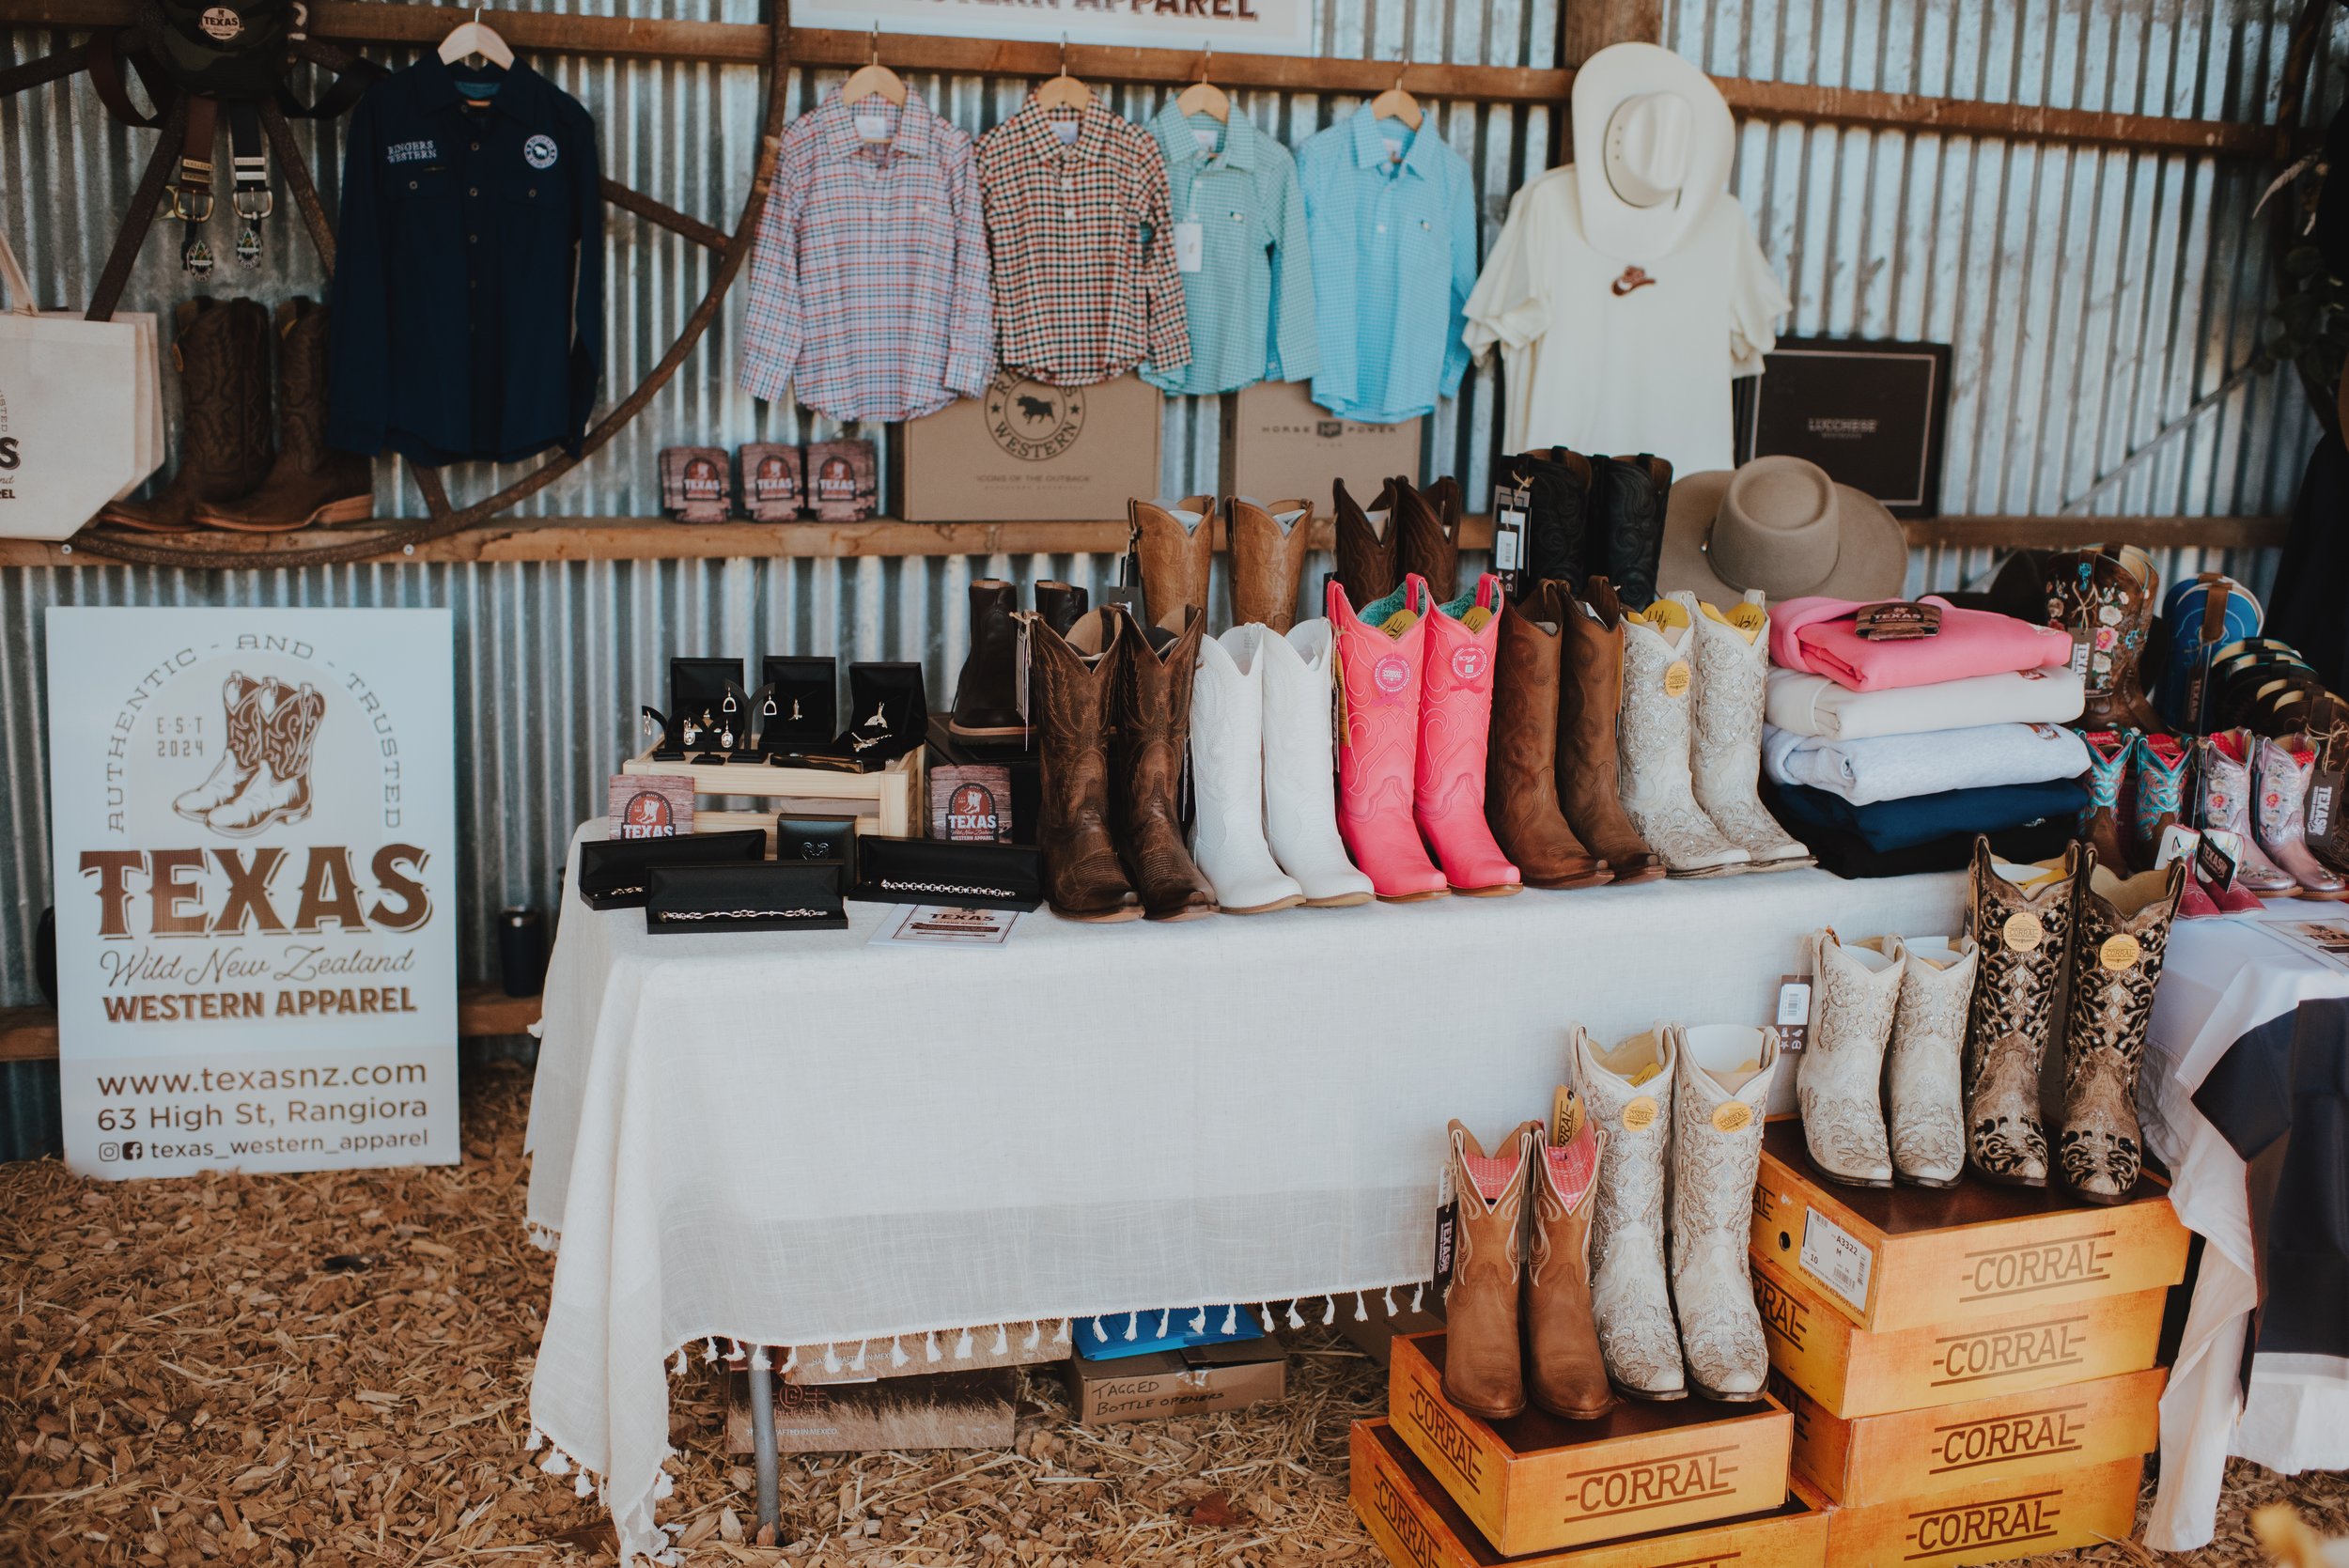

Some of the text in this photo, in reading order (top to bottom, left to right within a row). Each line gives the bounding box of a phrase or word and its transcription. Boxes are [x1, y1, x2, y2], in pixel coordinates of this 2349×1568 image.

[203, 16, 238, 26] TEXAS
[387, 149, 437, 163] WESTERN
[388, 140, 434, 156] RINGERS
[994, 420, 1078, 458] WESTERN
[684, 479, 721, 490] TEXAS
[755, 479, 792, 490] TEXAS
[819, 479, 855, 490] TEXAS
[1046, 474, 1090, 483] OUTBACK
[107, 634, 401, 833] AUTHENTIC AND TRUSTED
[157, 740, 204, 757] 2024
[623, 825, 674, 839] TEXAS
[948, 815, 997, 830] TEXAS
[79, 844, 434, 940] TEXAS
[930, 913, 996, 922] TEXAS
[100, 944, 415, 987] Wild New Zealand
[2106, 949, 2134, 957] CORRAL
[101, 986, 417, 1023] WESTERN APPAREL
[97, 1063, 428, 1096] www.texasnz.com
[98, 1097, 428, 1132] 63 High St, Rangiora
[1558, 1110, 1573, 1146] RRAL
[151, 1129, 428, 1160] texas_western_apparel
[1441, 1219, 1453, 1264] TEXAS
[1835, 1248, 1842, 1257] M
[1836, 1234, 1859, 1256] A3322
[1810, 1253, 1818, 1265] 10
[1973, 1241, 2105, 1293] CORRAL
[1753, 1274, 1801, 1342] RRAL
[1945, 1326, 2077, 1377] CORRAL
[1092, 1381, 1159, 1400] TAGGED
[1096, 1392, 1225, 1416] BOTTLE OPENERS
[809, 1427, 838, 1436] MEXICO
[1414, 1389, 1476, 1480] CORRAL
[1943, 1413, 2077, 1465] CORRAL
[1579, 1455, 1730, 1513] CORRAL
[1378, 1480, 1435, 1568] CORRAL
[1918, 1499, 2052, 1550] CORRAL
